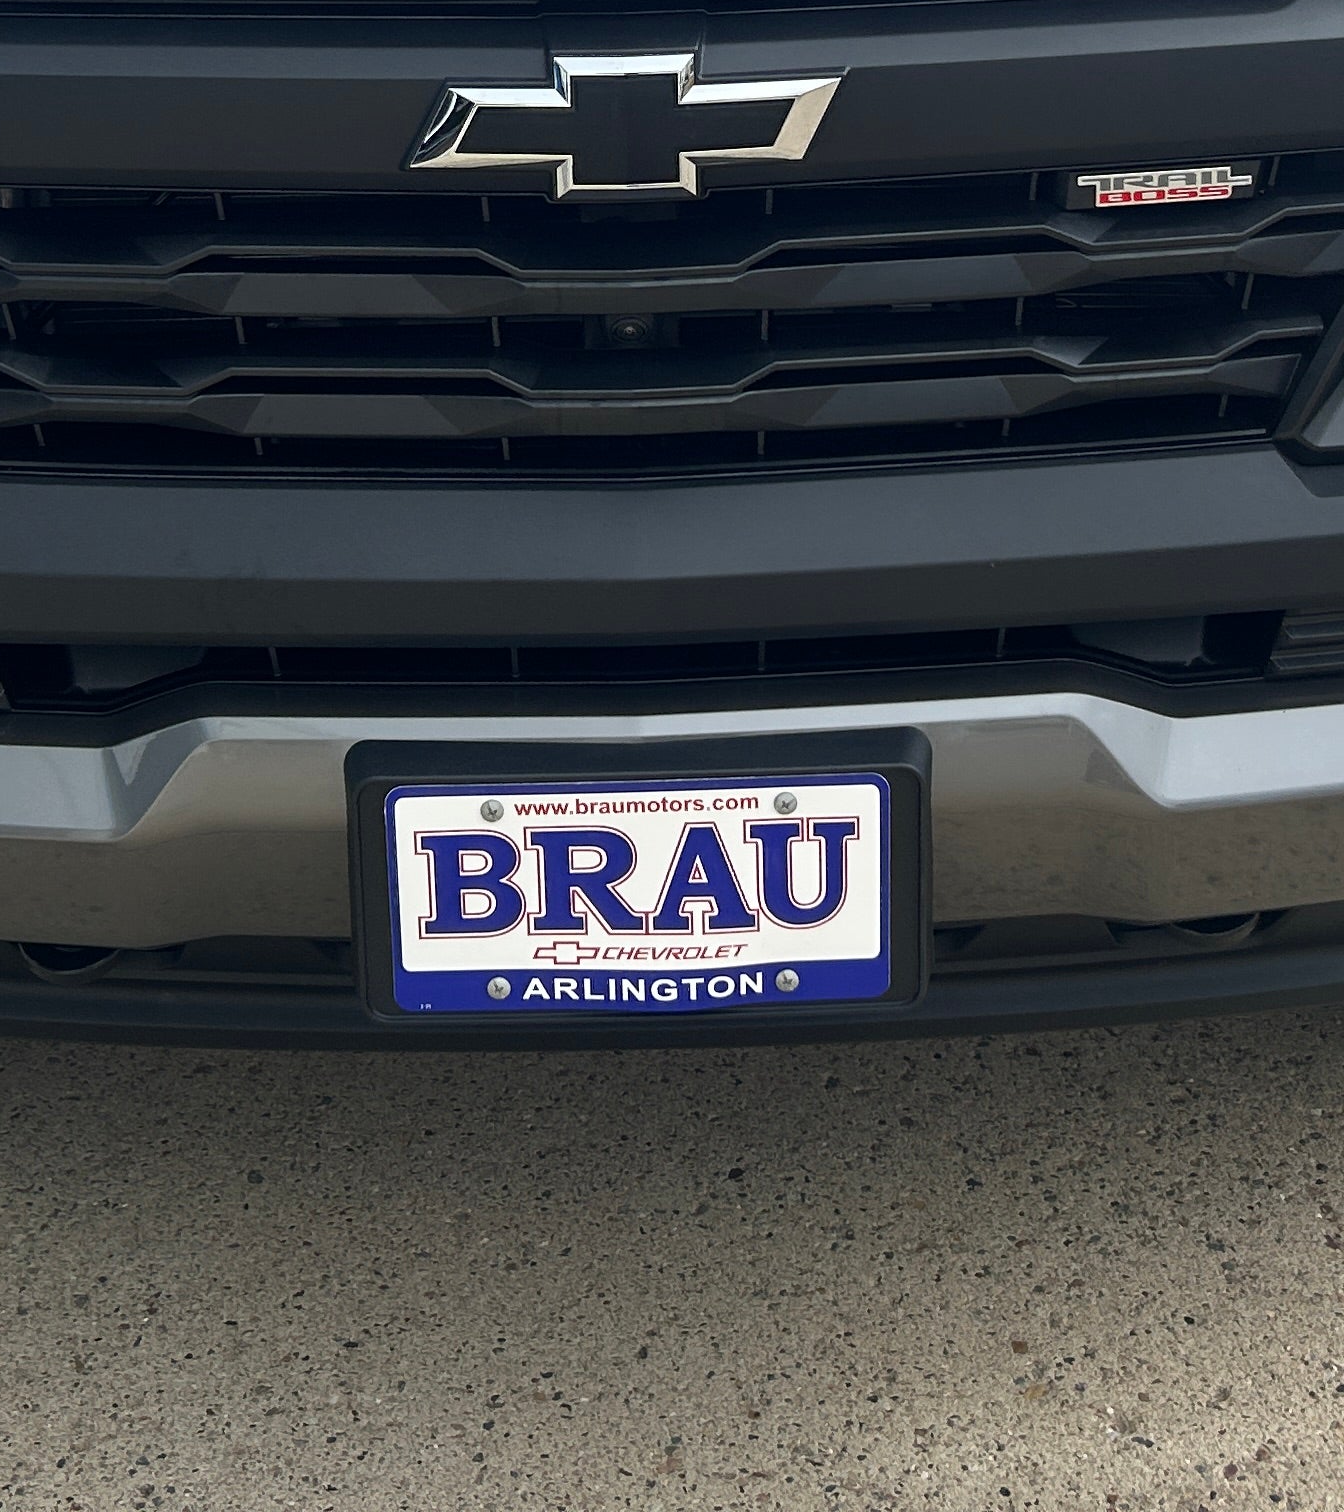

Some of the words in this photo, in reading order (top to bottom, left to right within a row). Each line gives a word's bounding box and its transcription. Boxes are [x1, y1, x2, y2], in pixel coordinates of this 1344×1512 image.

[1077, 166, 1253, 192] TRAIL
[1097, 184, 1232, 206] BOSS
[513, 793, 760, 818] www.braumotors.com
[413, 816, 861, 940] BRAU
[601, 943, 749, 961] CHEVROLET
[522, 972, 765, 1003] ARLINGTON
